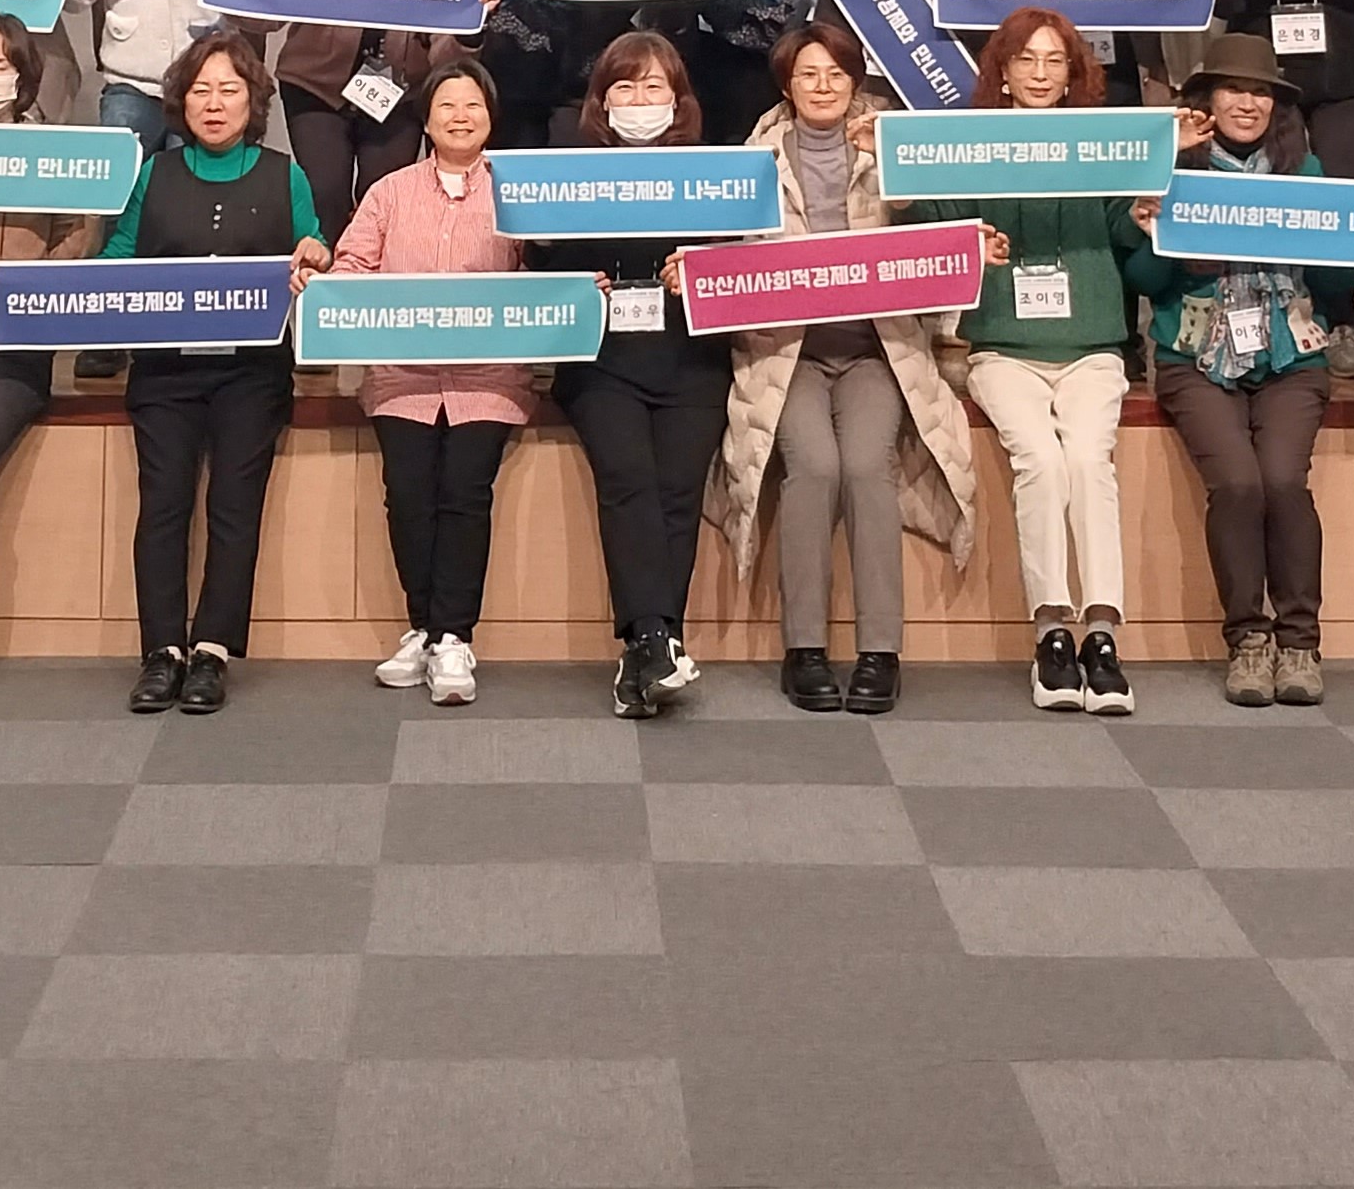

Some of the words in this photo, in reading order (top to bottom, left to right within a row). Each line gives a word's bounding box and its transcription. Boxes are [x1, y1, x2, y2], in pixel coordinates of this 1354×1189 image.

[914, 41, 962, 106] 만나다!!
[897, 143, 1070, 166] 안산시사회적경제와
[1078, 141, 1150, 163] 만나다!!
[38, 158, 112, 181] 만나다!!
[500, 181, 676, 205] 안산시사회적경제와
[684, 179, 757, 201] 나누다!!
[1172, 203, 1342, 232] 안산시사회적경제와
[696, 264, 870, 300] 안산시사회적경제와
[877, 253, 970, 283] 함께하다!!
[7, 292, 186, 316] 안산시사회적경제와
[195, 289, 269, 313] 만나다!!
[319, 307, 495, 330] 안산시사회적경제와
[504, 305, 577, 329] 만나다!!
